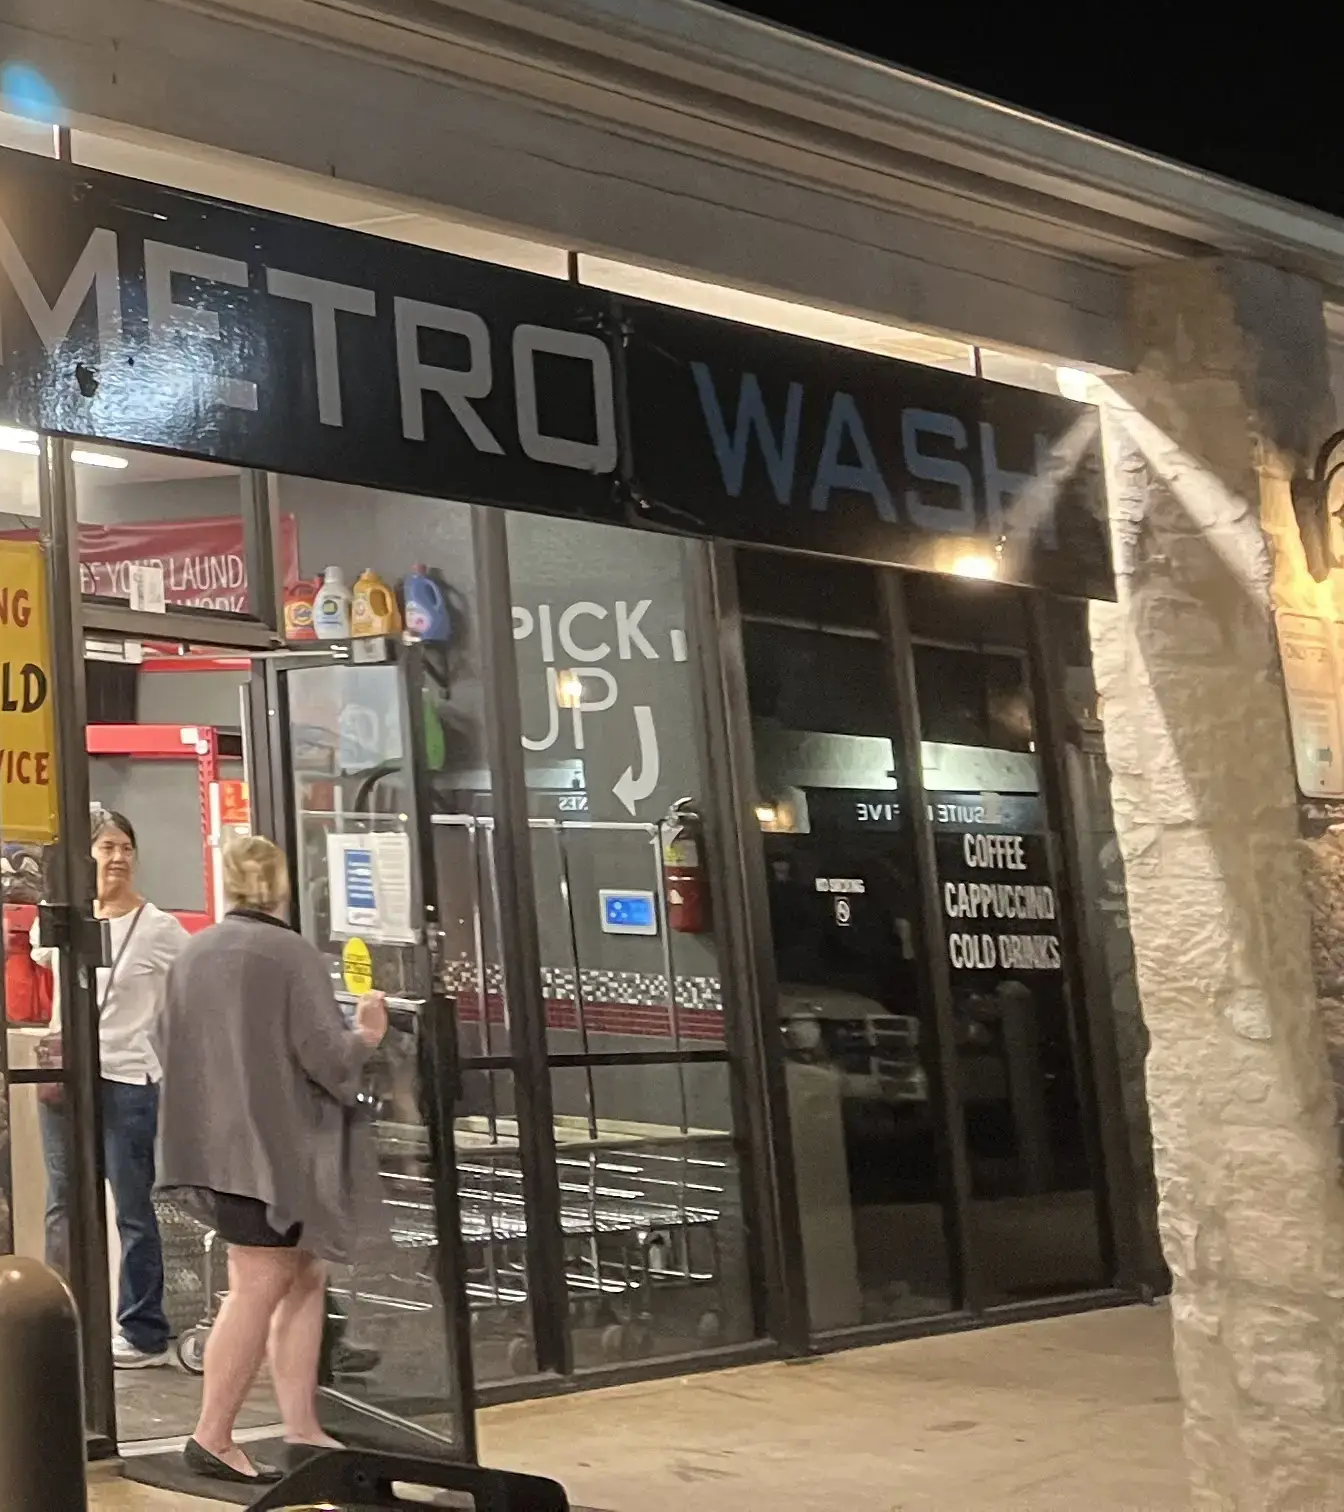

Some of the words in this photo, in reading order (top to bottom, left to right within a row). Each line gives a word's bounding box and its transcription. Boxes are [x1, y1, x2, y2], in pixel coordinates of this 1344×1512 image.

[689, 361, 1059, 551] WASH
[106, 559, 165, 594] YO
[511, 599, 661, 663] PICK
[963, 833, 1028, 870] COFFEE
[944, 882, 1056, 920] CAPPUCCINO
[949, 933, 997, 969] COLD
[998, 934, 1062, 969] DRINKS
